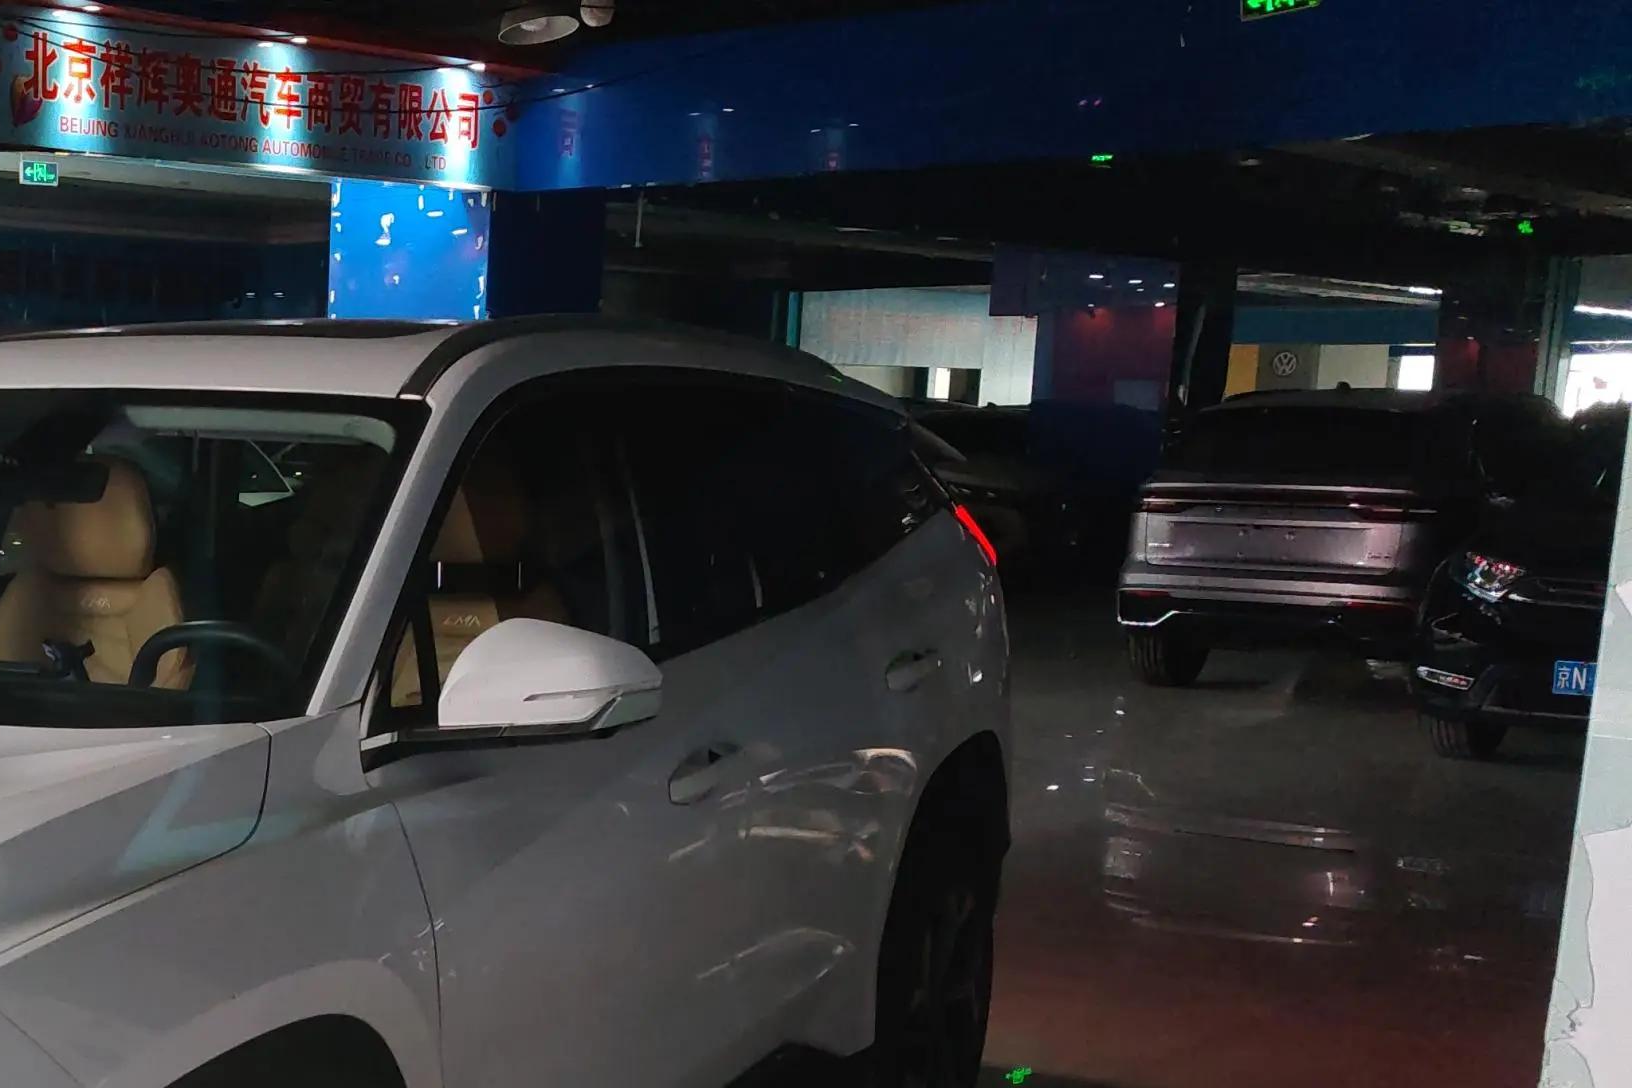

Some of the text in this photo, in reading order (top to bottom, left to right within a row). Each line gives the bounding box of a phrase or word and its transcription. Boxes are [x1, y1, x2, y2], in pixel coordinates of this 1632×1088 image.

[23, 31, 480, 149] 北京祥辉奥通汽车商贸有限公司
[59, 116, 120, 138] BEIJING
[262, 137, 350, 162] AUTOMOE
